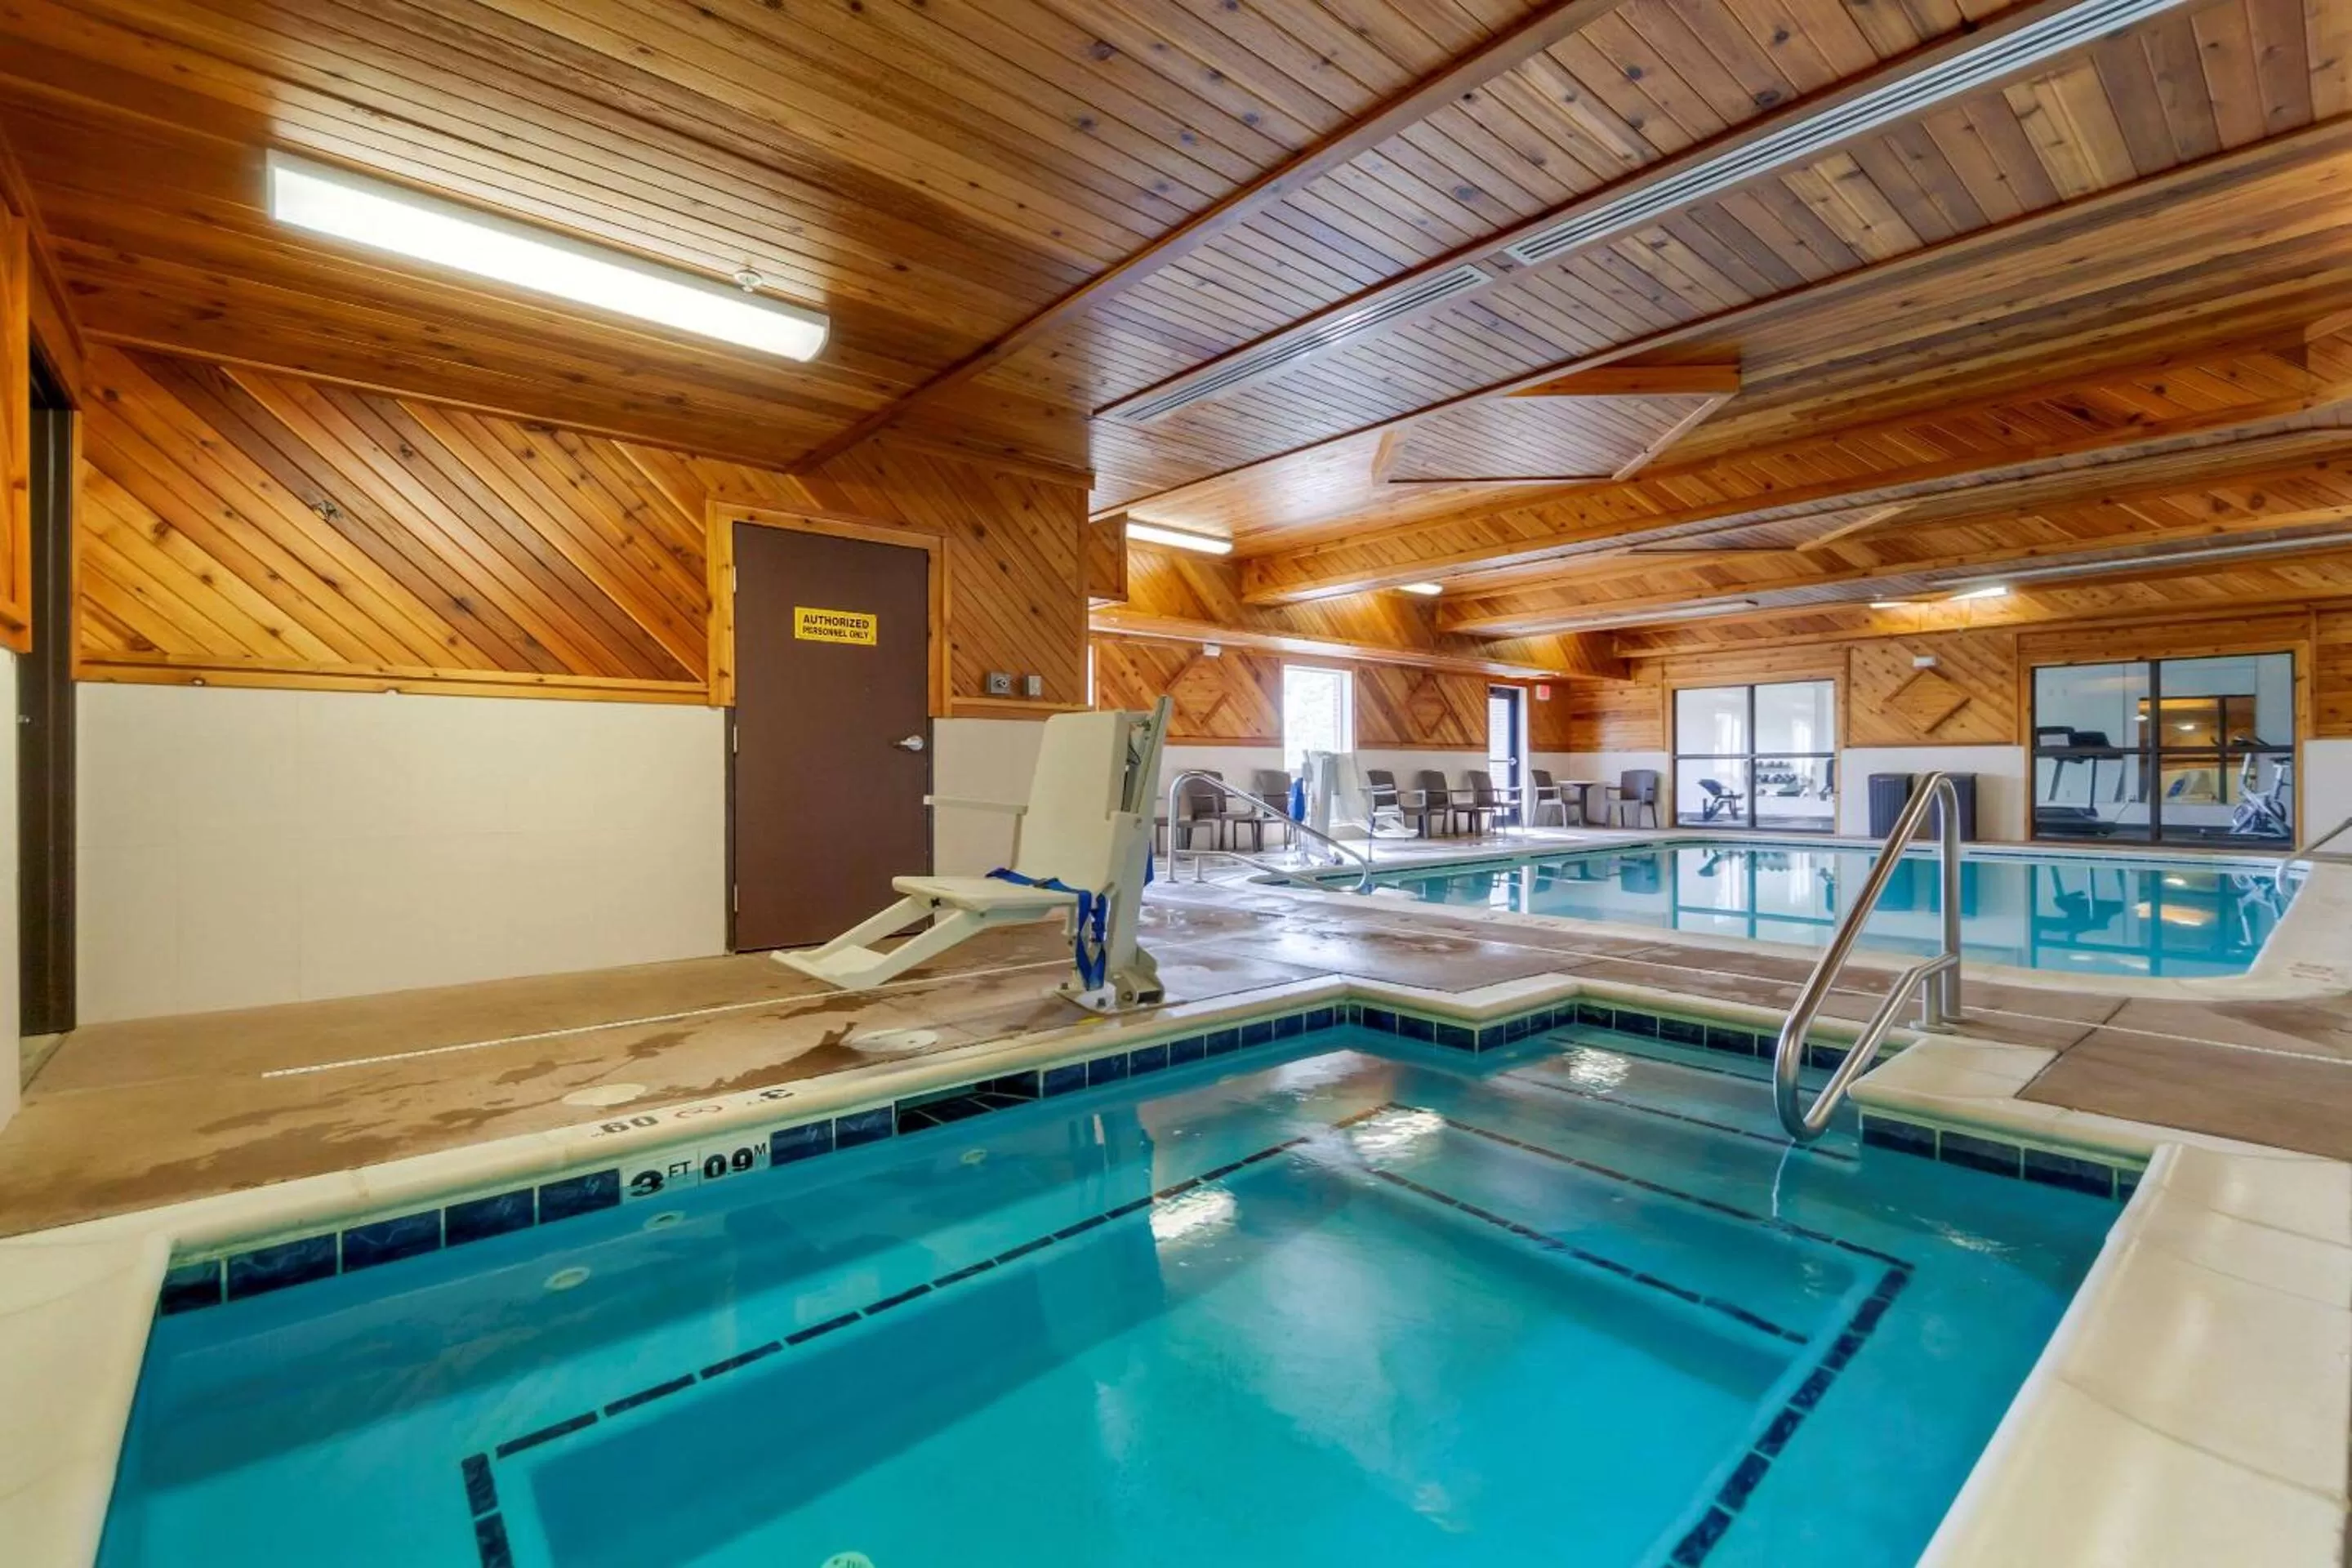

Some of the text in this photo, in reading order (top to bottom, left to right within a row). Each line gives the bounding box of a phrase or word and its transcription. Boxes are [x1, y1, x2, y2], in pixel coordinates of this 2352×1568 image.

[804, 614, 869, 629] AUTHORIZED
[803, 626, 869, 639] PERSONNEL ONLY
[630, 1169, 665, 1196] 3
[669, 1160, 692, 1178] FT
[754, 1143, 766, 1156] M
